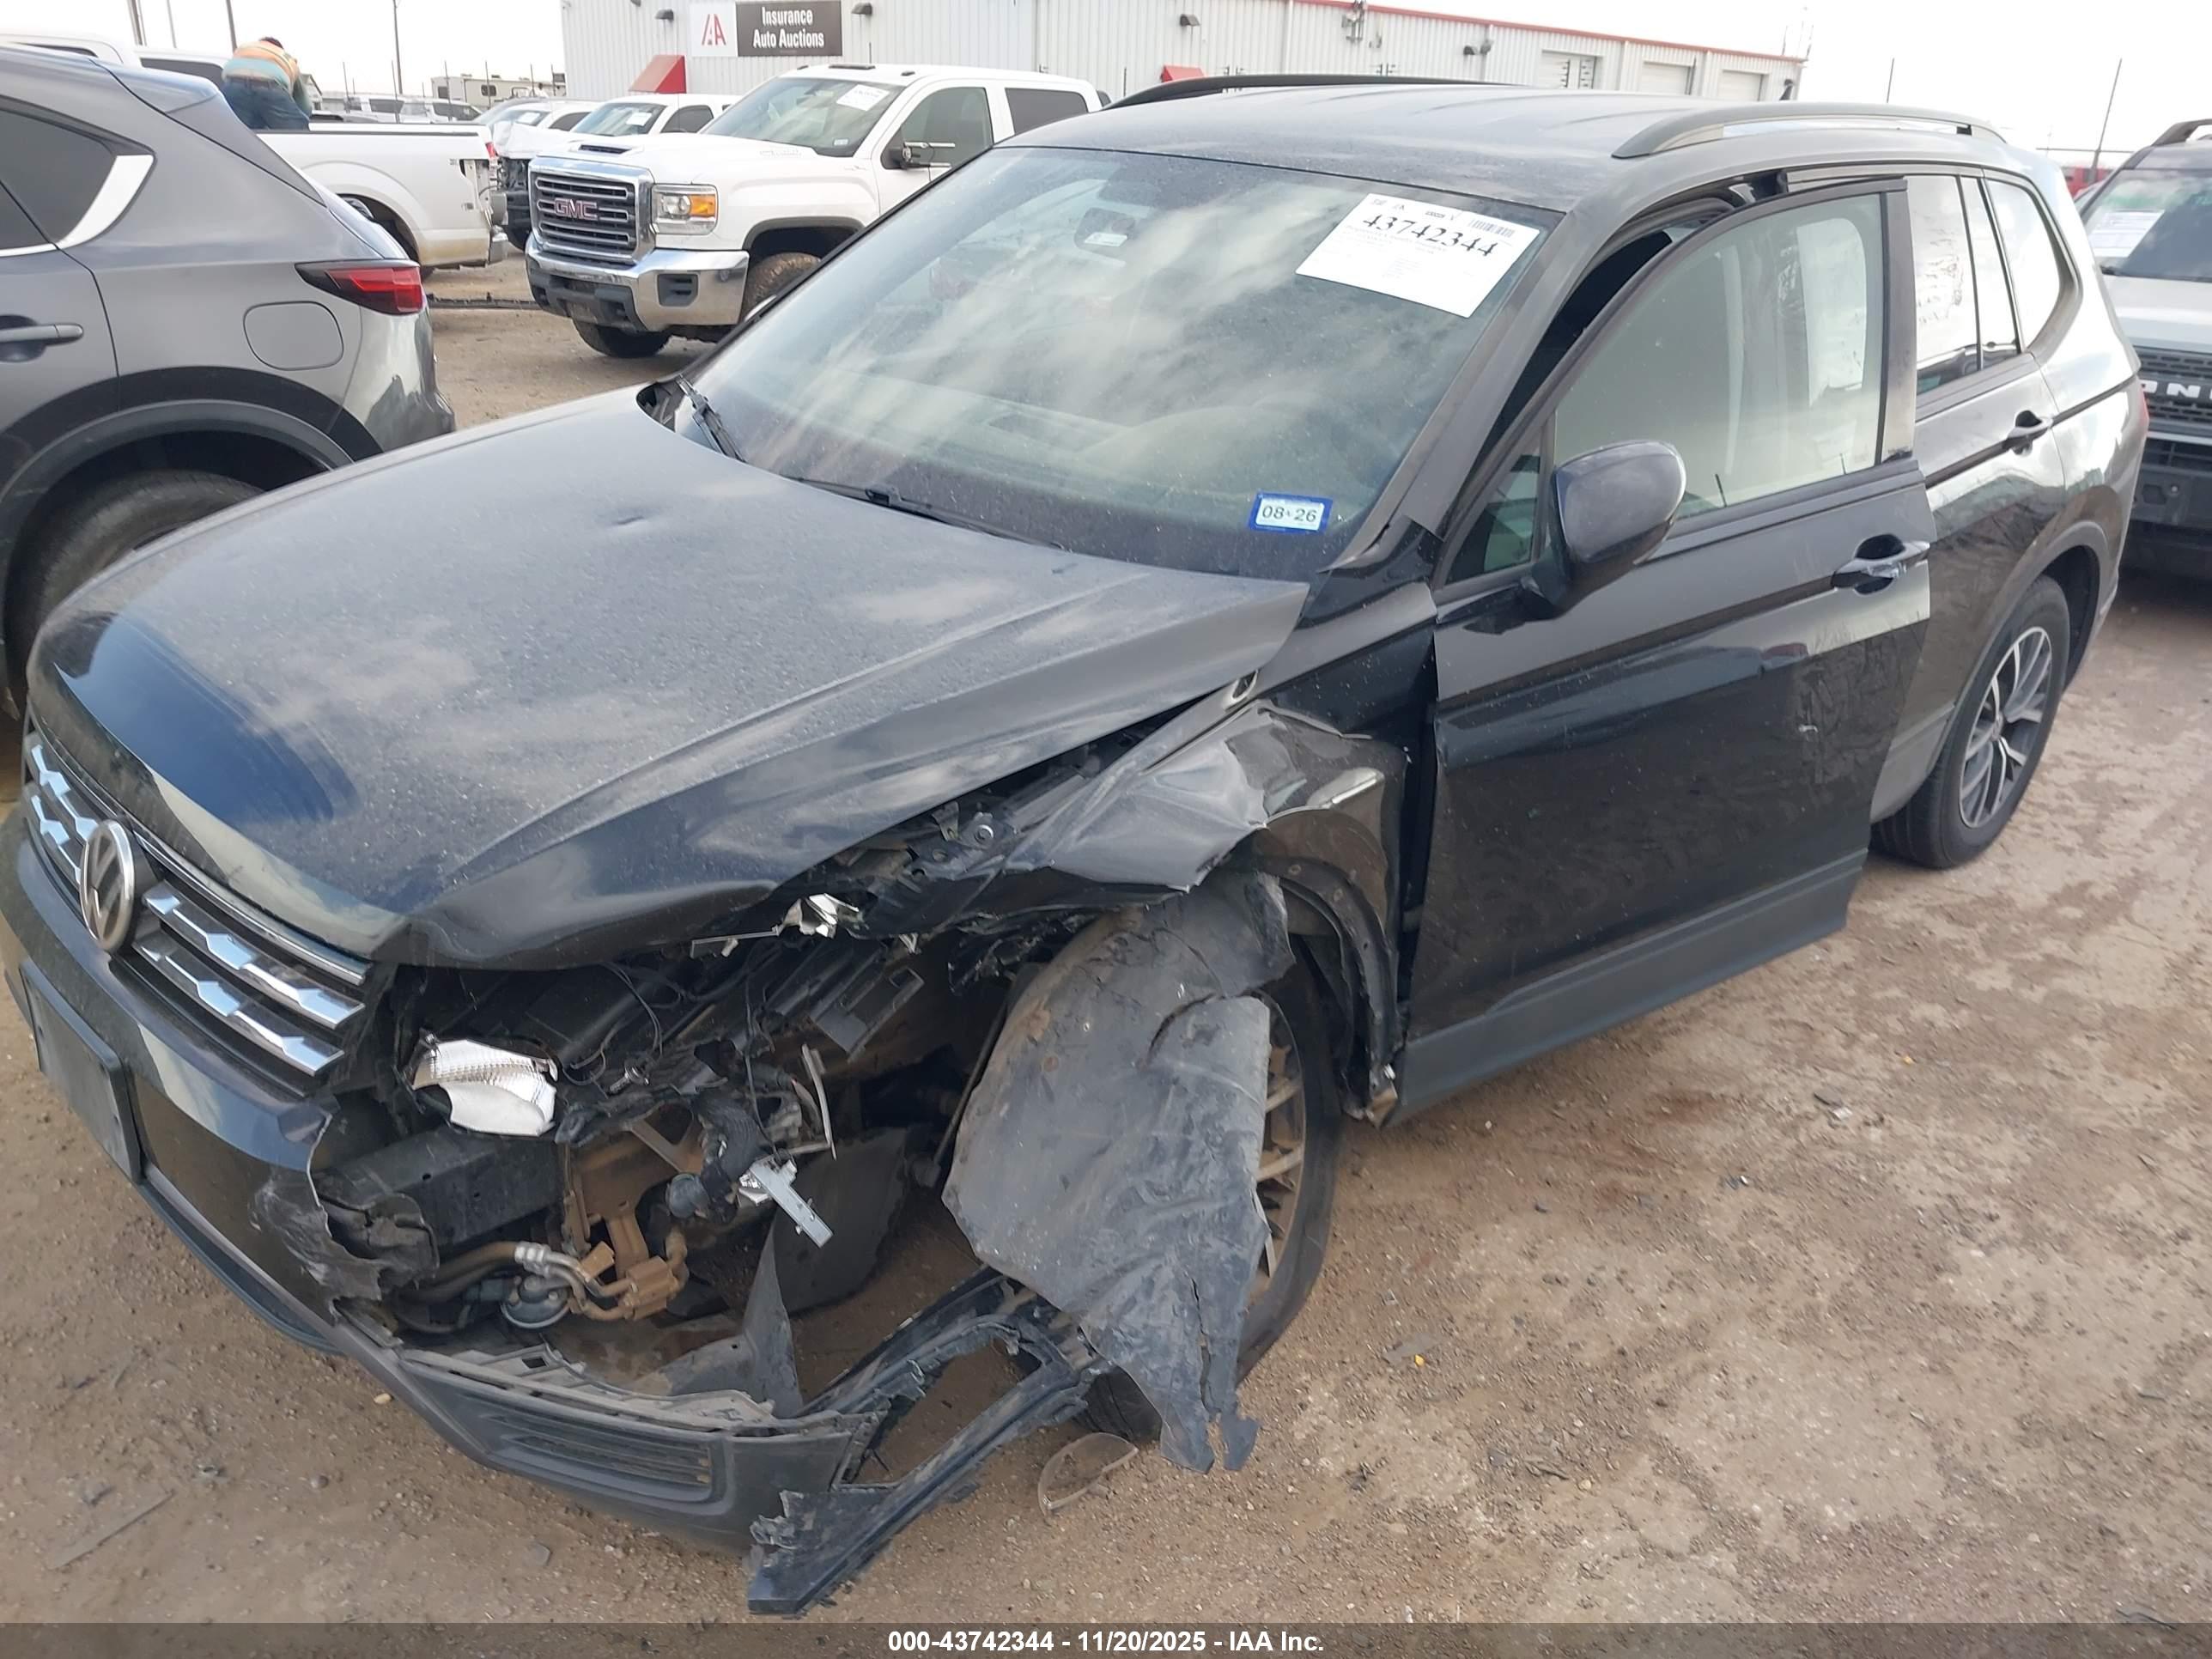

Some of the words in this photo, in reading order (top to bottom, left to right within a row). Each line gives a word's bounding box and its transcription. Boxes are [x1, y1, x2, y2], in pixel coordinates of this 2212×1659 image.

[761, 6, 813, 27] Insurance
[752, 28, 777, 49] Auto
[778, 28, 825, 49] Auctions
[554, 197, 599, 221] GMC
[1362, 213, 1499, 258] 43742344
[1293, 507, 1317, 523] 26
